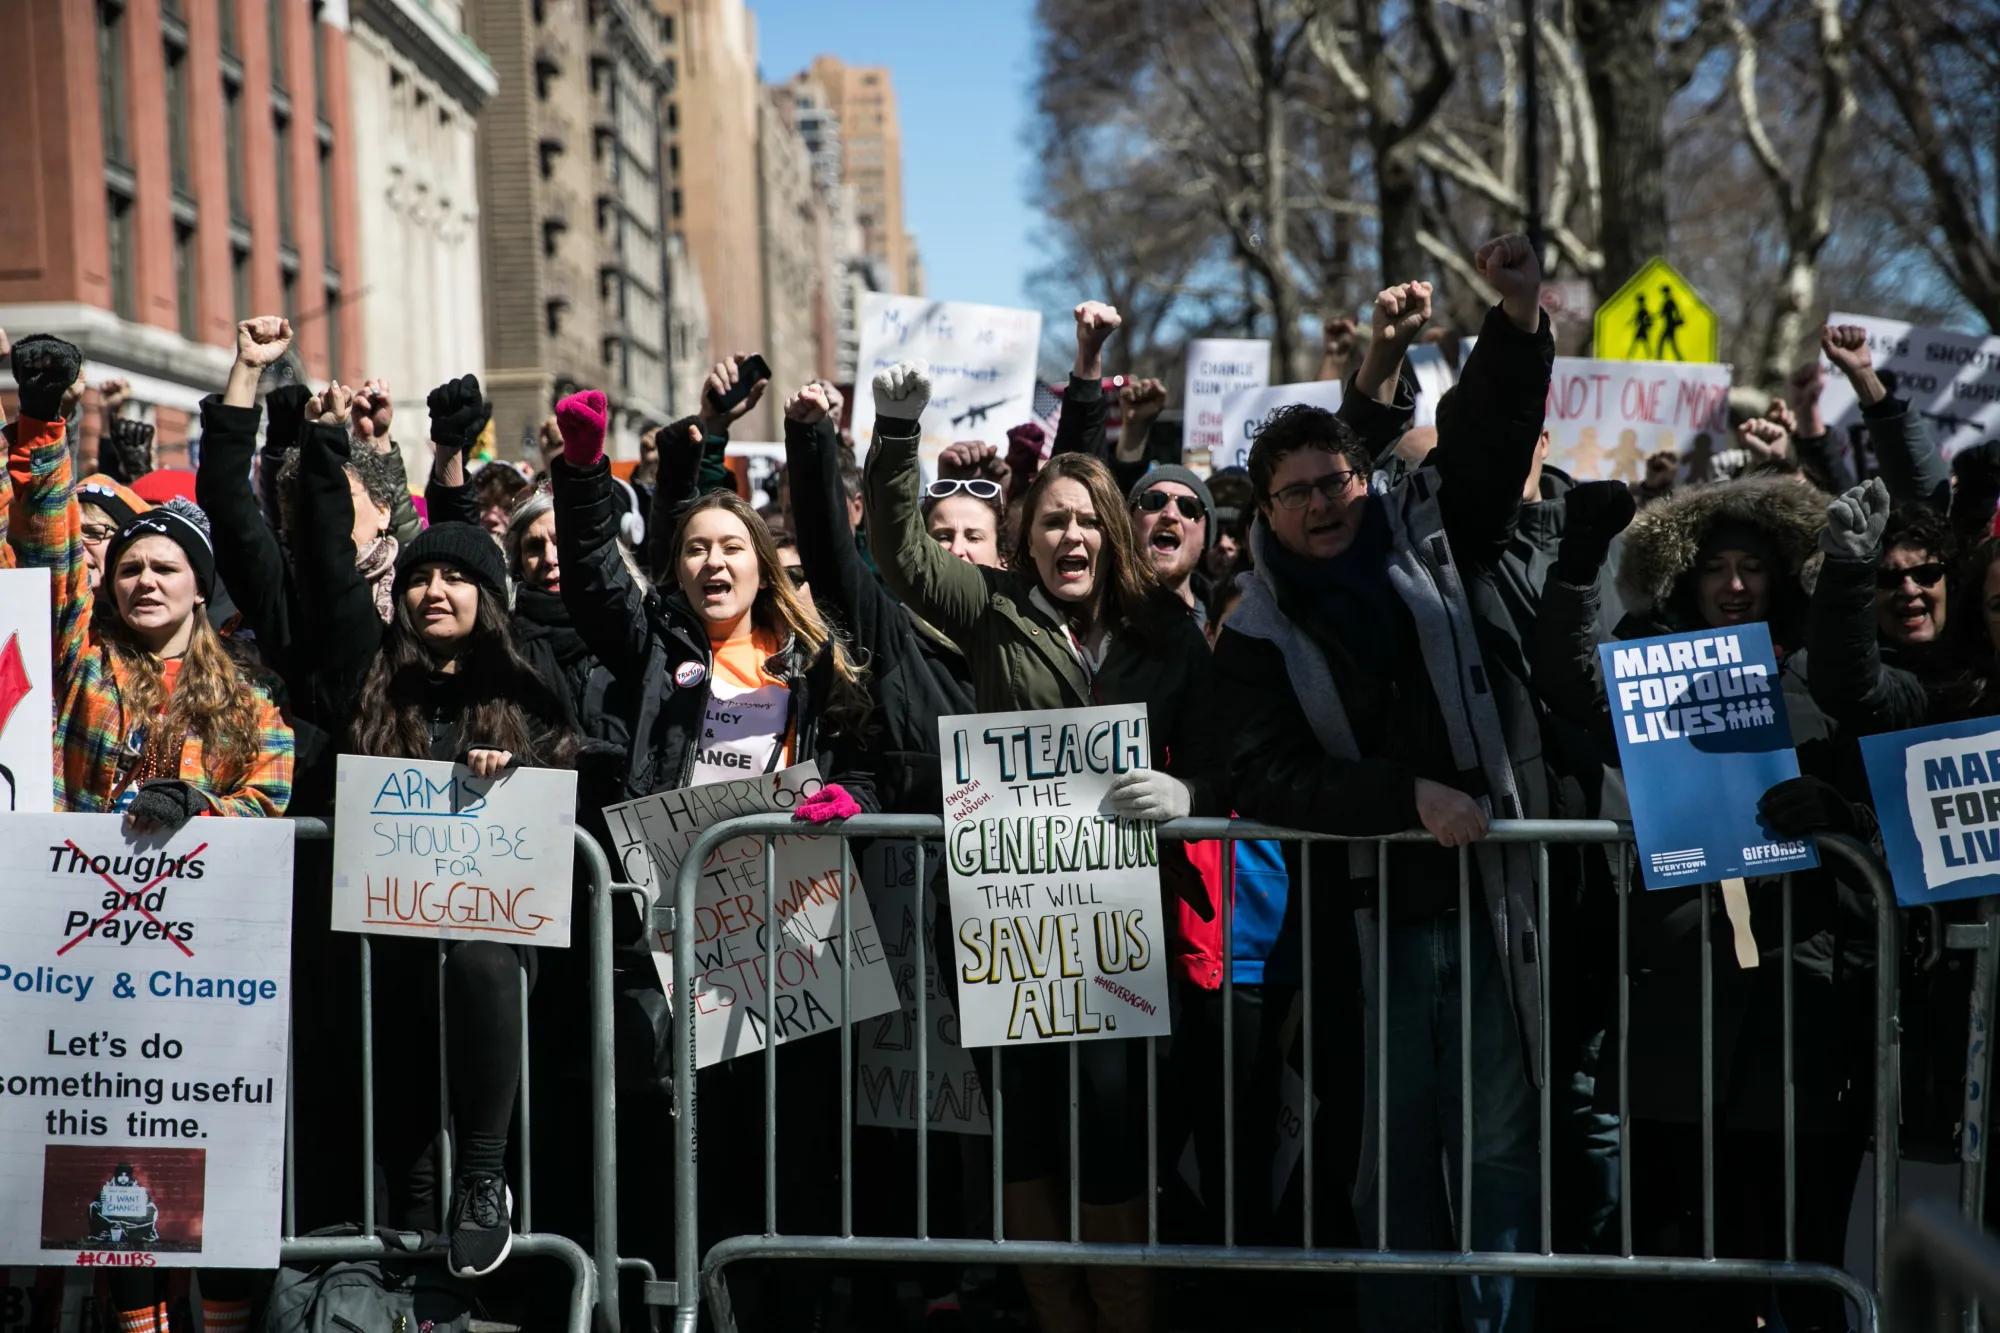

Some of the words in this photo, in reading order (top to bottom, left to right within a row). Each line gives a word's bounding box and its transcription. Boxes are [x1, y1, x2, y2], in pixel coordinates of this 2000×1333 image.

[1545, 373, 1611, 421] NOT
[1620, 376, 1666, 425] ONE
[677, 667, 701, 680] TRUMP
[1613, 634, 1743, 679] MARCH
[1618, 674, 1692, 711] FOR
[1692, 664, 1771, 702] OUR
[704, 728, 714, 738] &
[705, 709, 743, 725] LICY
[1624, 703, 1726, 744] LIVES
[696, 749, 752, 770] ANGE
[954, 729, 971, 785] I
[983, 718, 1149, 783] TEACH
[373, 768, 487, 813] ARMS
[945, 779, 981, 806] ENOUGH
[961, 797, 972, 808] IS
[1008, 781, 1072, 807] THE
[1931, 788, 2000, 829] FOR
[607, 800, 653, 848] IF
[660, 778, 773, 833] HARRY
[374, 822, 481, 857] SHOULD
[487, 825, 534, 860] BE
[949, 814, 1159, 877] GENERATION
[1742, 840, 1806, 861] GIFFORDS
[1939, 828, 2000, 868] LIV
[49, 846, 206, 884] Thoughts
[435, 855, 482, 877] FOR
[703, 859, 766, 896] THE
[1653, 859, 1707, 873] EVERYTOWN
[101, 887, 167, 912] and
[366, 874, 554, 930] HUGGING
[977, 883, 1035, 909] THAT
[1046, 883, 1103, 907] WILL
[64, 910, 195, 946] Prayers
[695, 933, 751, 970] WE
[959, 913, 1084, 984] SAVE
[1094, 909, 1151, 975] US
[112, 972, 137, 999] &
[149, 970, 278, 1006] Change
[1094, 975, 1157, 1017] #NEVERAGAIN
[745, 988, 834, 1045] NRA
[1007, 978, 1117, 1040] ALL.
[47, 1029, 128, 1057] Let’s
[141, 1033, 183, 1059] do
[0, 1071, 164, 1105] omething
[172, 1076, 274, 1104] useful
[46, 1109, 108, 1136] this
[127, 1111, 208, 1138] time.
[106, 1204, 141, 1212] CHANGE
[117, 1195, 140, 1203] WANT
